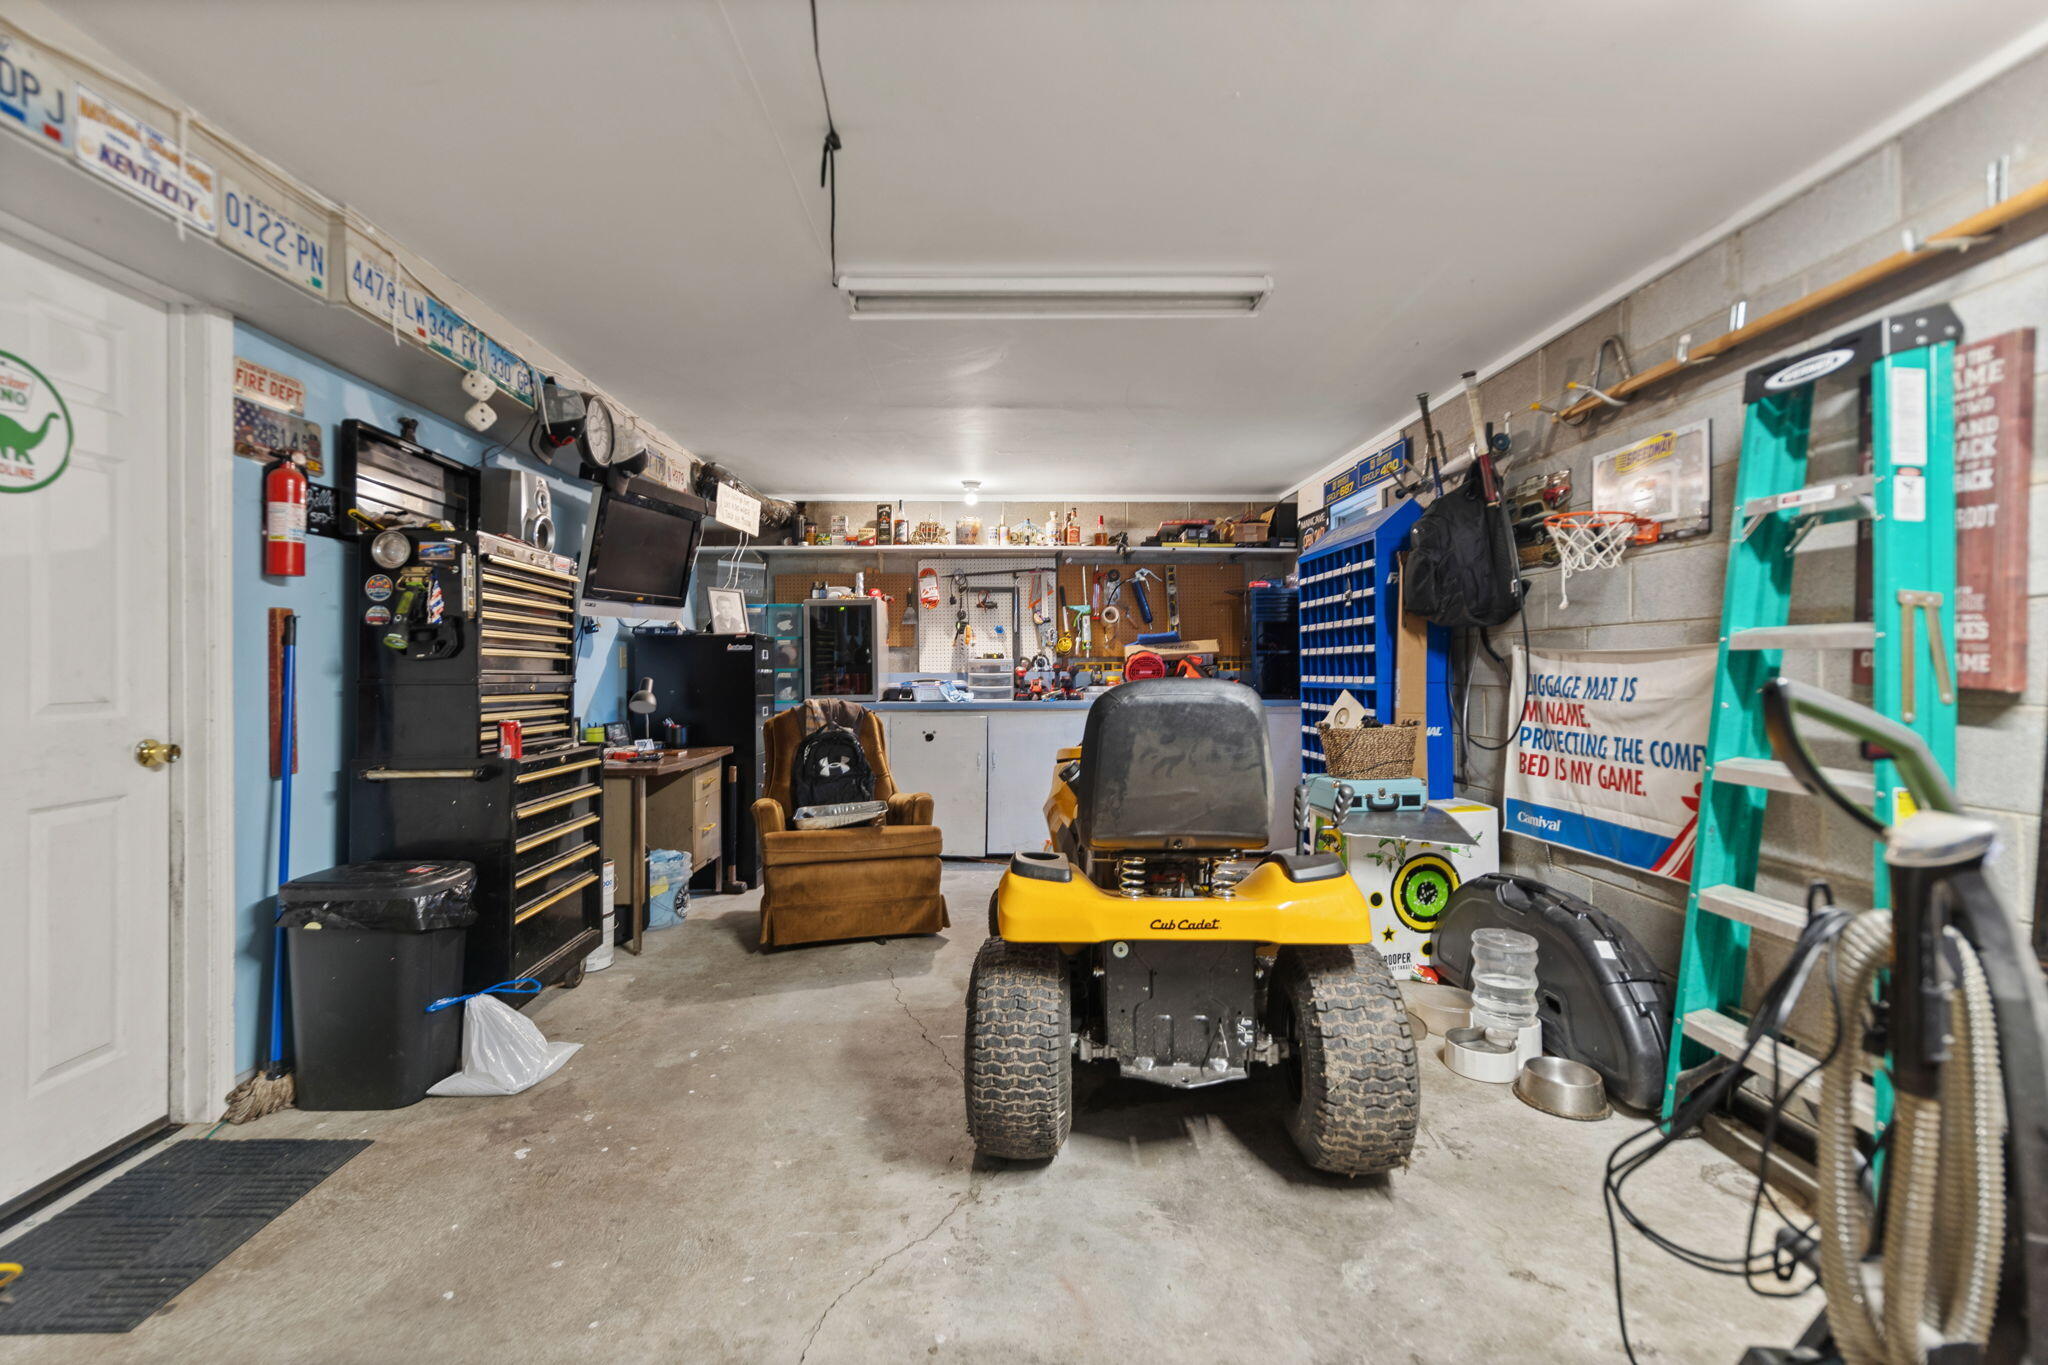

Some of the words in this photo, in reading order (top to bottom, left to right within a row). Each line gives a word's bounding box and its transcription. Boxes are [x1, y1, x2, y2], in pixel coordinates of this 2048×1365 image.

[226, 191, 324, 277] 0122-PN
[235, 367, 266, 393] FIRE
[270, 380, 303, 406] DEPT.
[1583, 676, 1618, 701] MAT
[1620, 677, 1638, 702] IS
[1546, 703, 1591, 728] NAME.
[1519, 726, 1608, 760] PROTECTING
[1614, 736, 1645, 765] THE
[1519, 751, 1550, 777] BED
[1555, 757, 1567, 782] IS
[1570, 759, 1593, 786] MY
[1598, 764, 1647, 797] GAME.
[1150, 918, 1176, 930] Cub
[1177, 918, 1221, 930] Cadet
